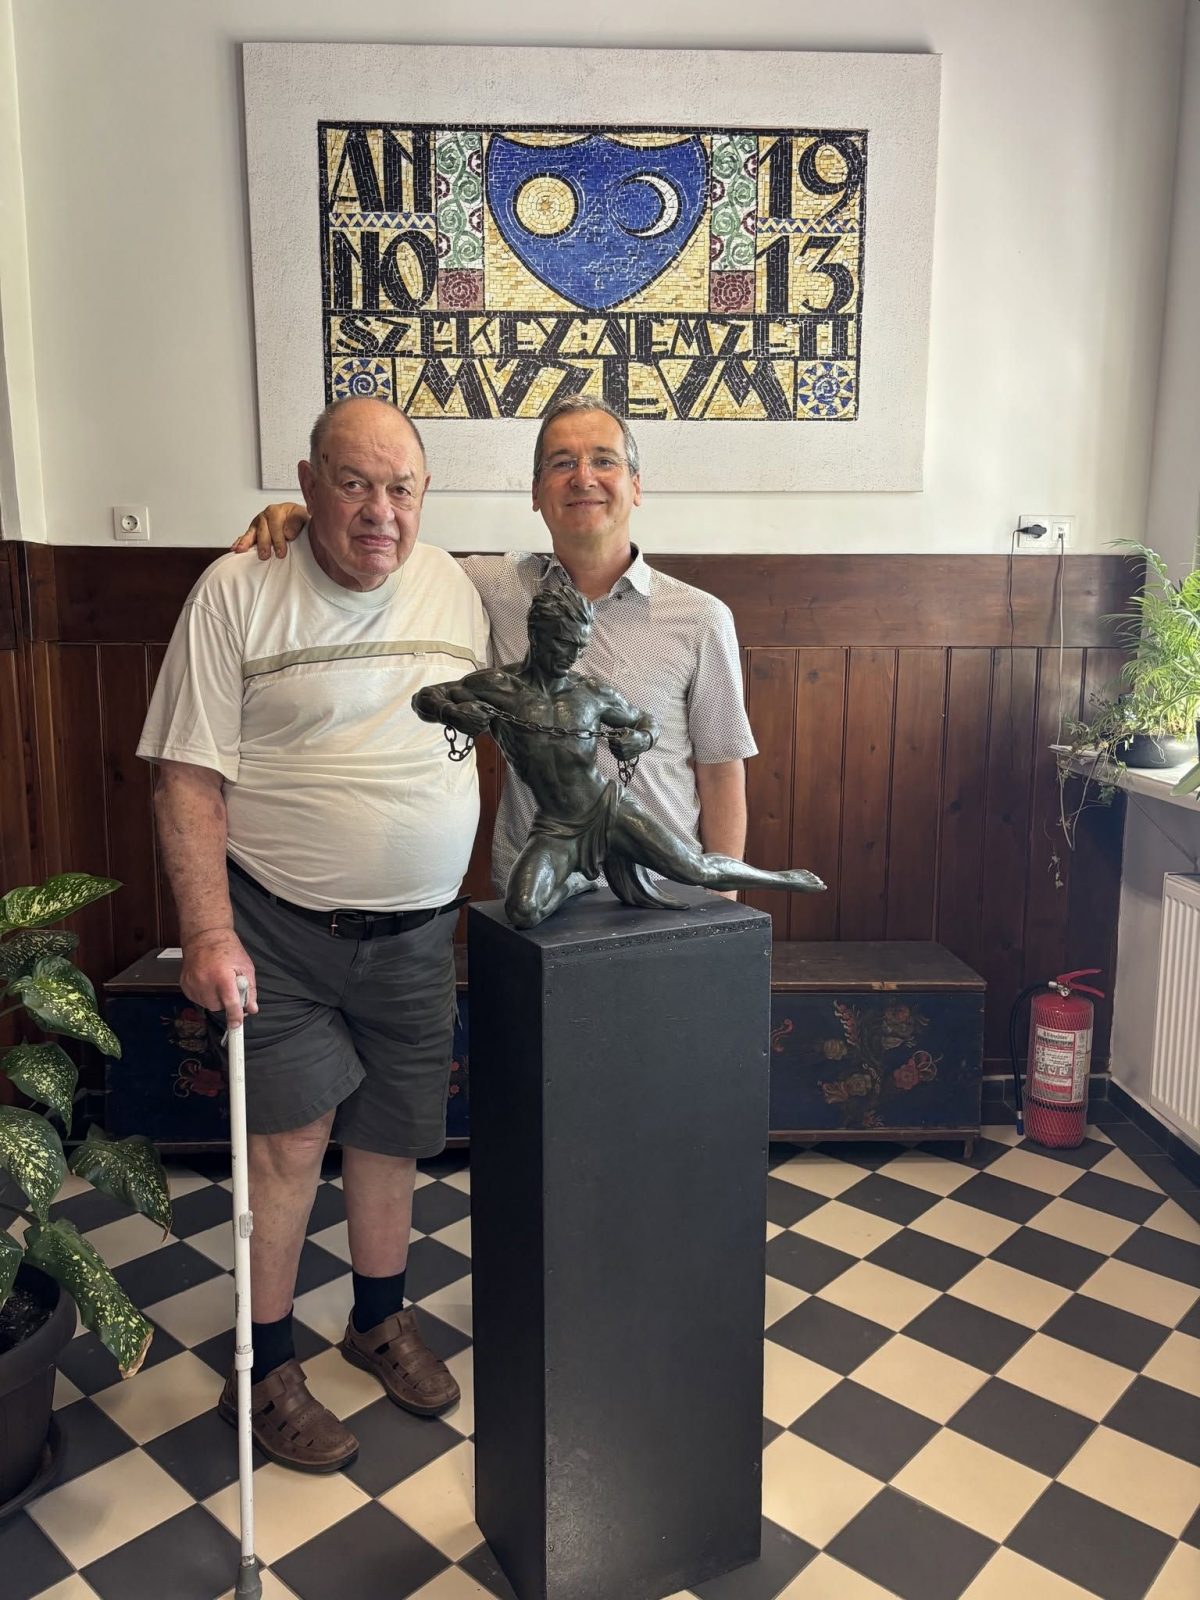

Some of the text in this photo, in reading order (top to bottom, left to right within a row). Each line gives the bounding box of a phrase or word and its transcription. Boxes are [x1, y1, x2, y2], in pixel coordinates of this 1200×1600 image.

[331, 129, 433, 213] AN
[757, 136, 861, 222] 19
[333, 230, 438, 310] NO
[755, 234, 855, 313] 13
